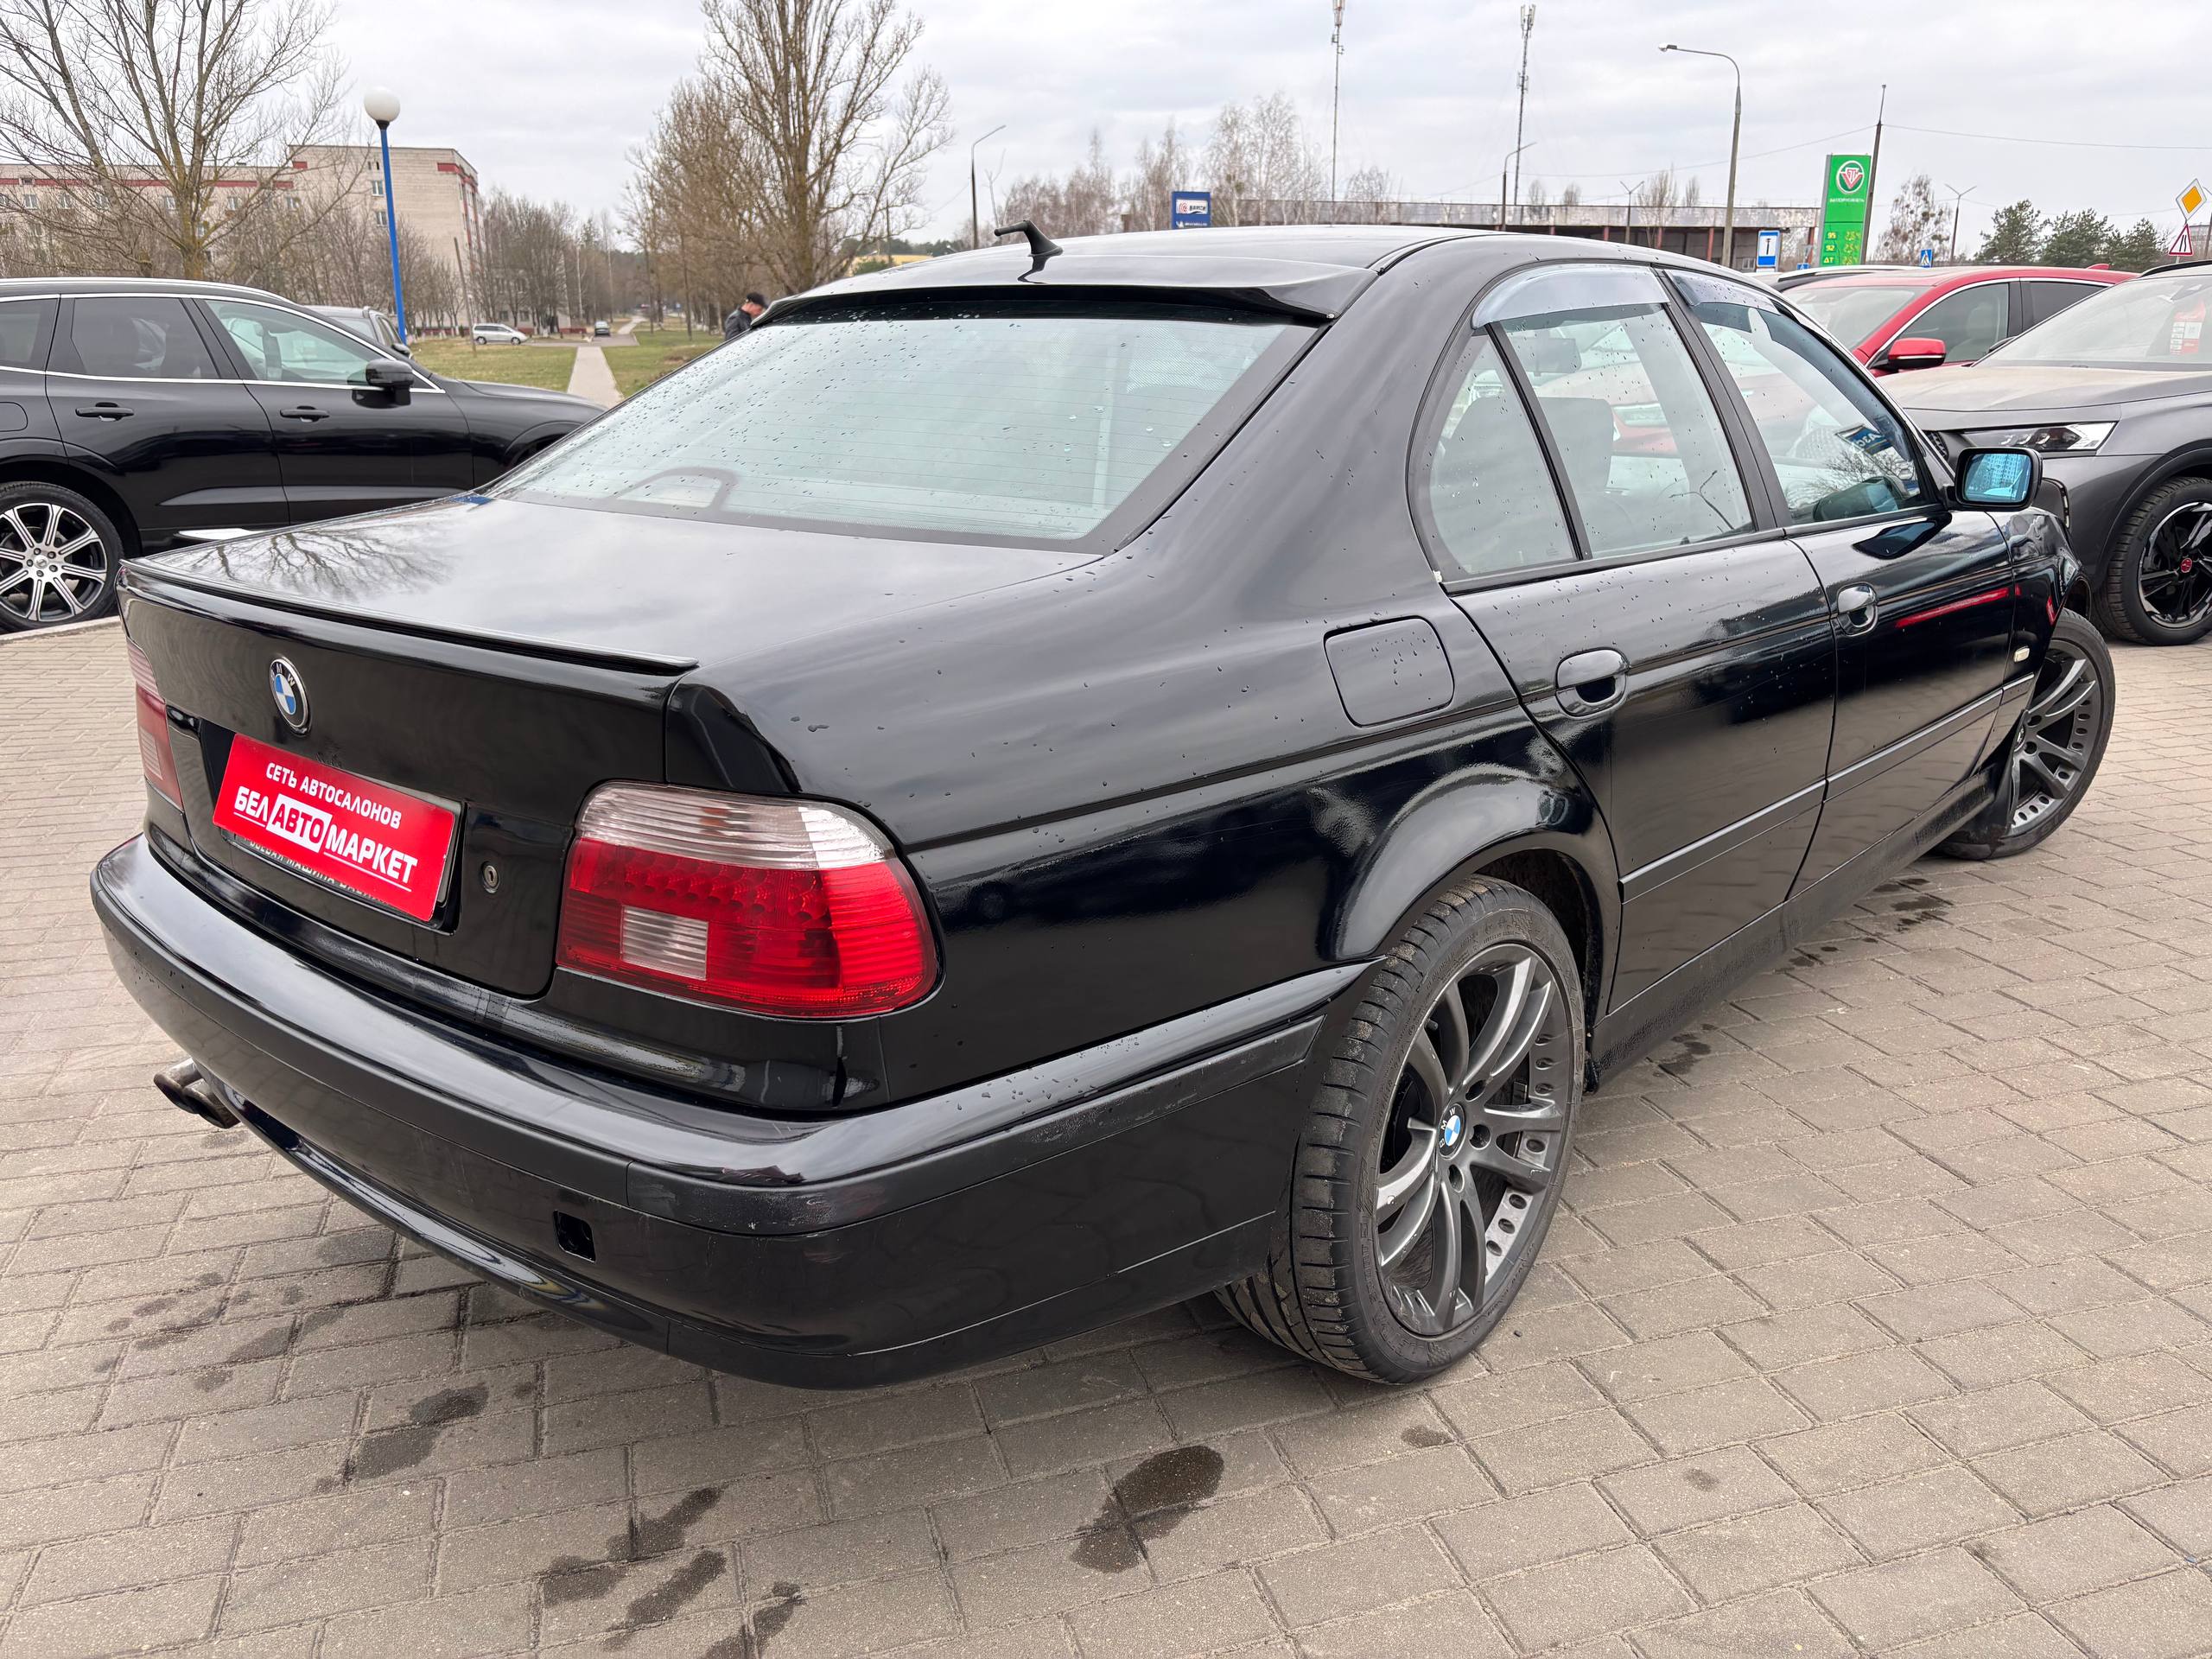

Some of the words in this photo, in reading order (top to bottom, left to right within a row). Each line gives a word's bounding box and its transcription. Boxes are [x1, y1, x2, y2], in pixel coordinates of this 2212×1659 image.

[265, 762, 297, 788] СЕТЬ
[299, 776, 402, 830] АВТОСАЛОНОВ
[234, 785, 418, 884] БЕЛАВТОМАРКЕТ
[1439, 1107, 1456, 1148] BMW
